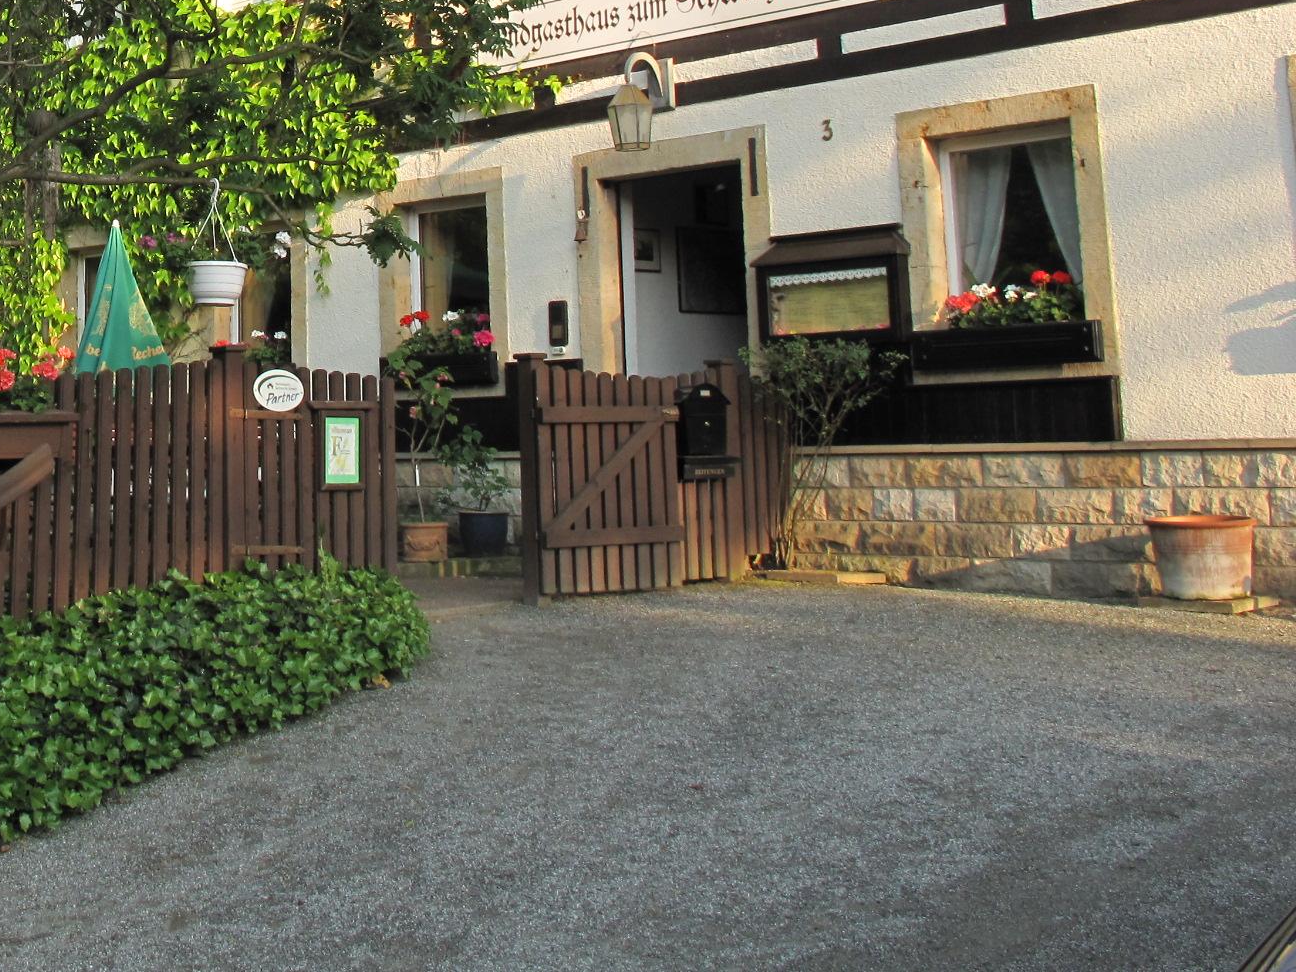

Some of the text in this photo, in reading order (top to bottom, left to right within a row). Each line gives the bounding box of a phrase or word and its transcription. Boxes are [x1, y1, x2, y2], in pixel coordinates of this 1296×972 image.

[504, 5, 620, 52] ndgasthaus
[821, 118, 833, 141] 3
[266, 392, 300, 406] Partner
